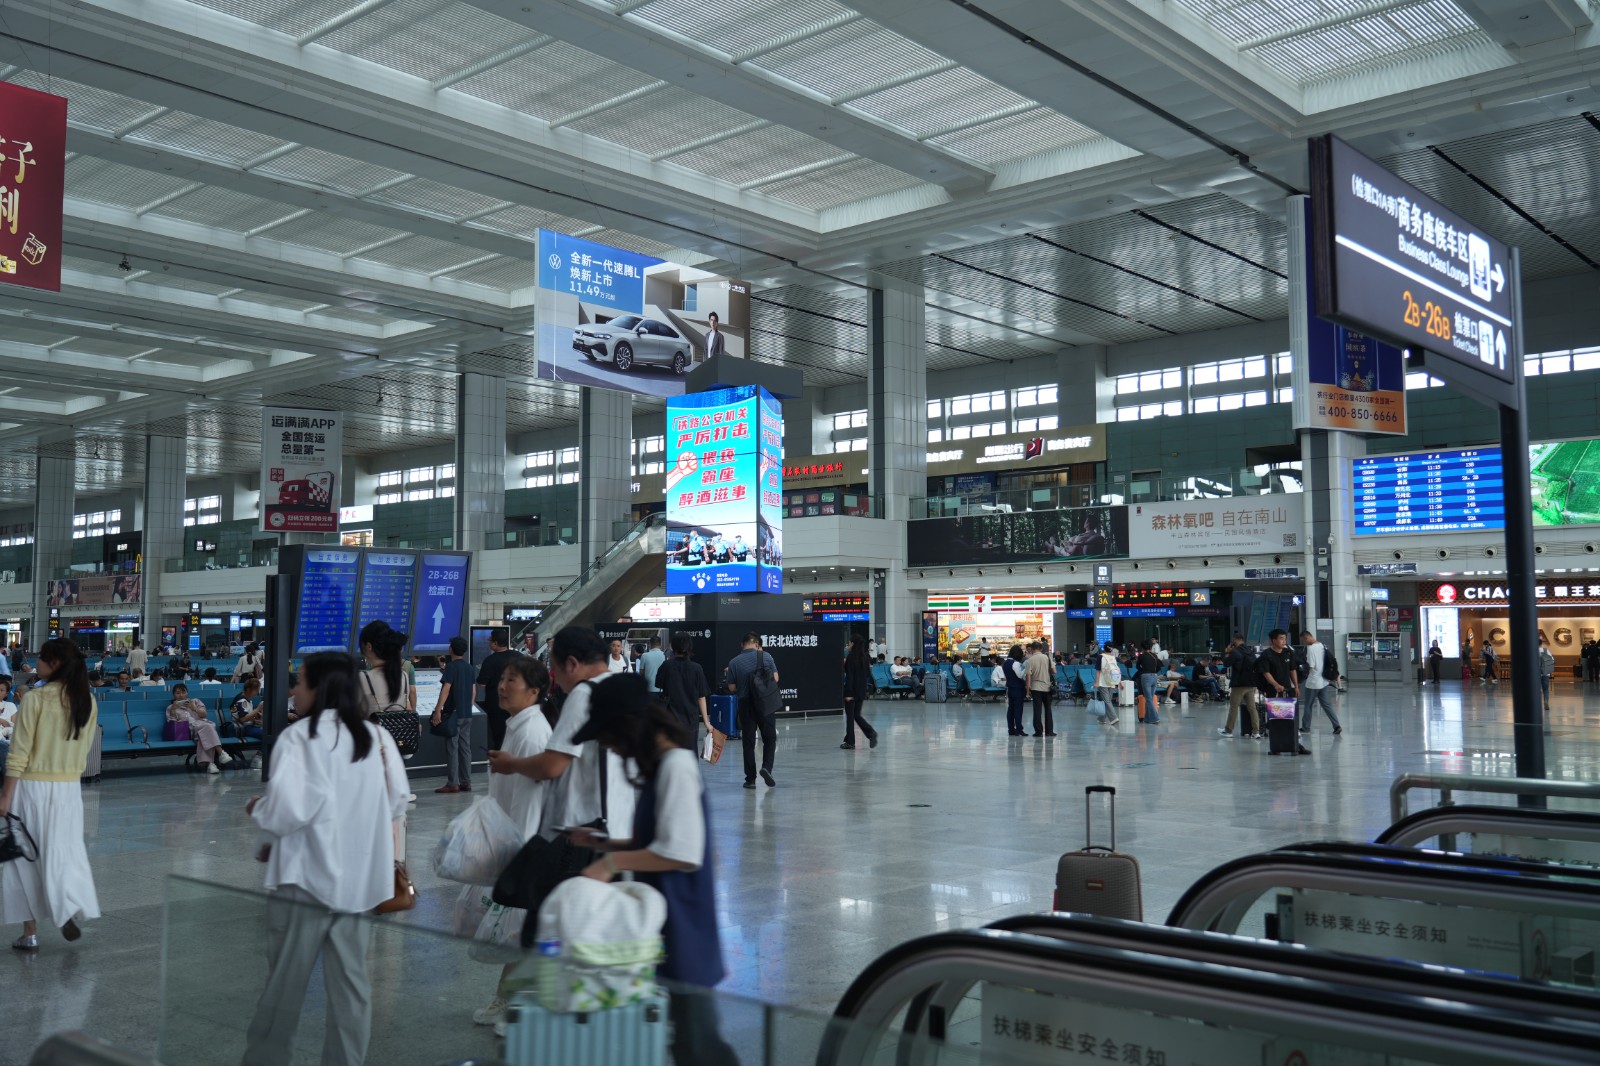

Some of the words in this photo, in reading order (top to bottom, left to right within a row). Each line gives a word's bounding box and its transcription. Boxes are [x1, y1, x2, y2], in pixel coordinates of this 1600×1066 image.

[570, 251, 641, 279] 全新一代速腾L
[1398, 234, 1428, 266] Business
[1428, 247, 1447, 275] Class
[1447, 258, 1470, 289] Lounge
[569, 267, 613, 287] 焕新上市
[1454, 311, 1478, 342] 检票口
[271, 415, 336, 430] 运满满APP
[677, 406, 749, 432] 铁路公安机关
[1327, 405, 1398, 423] 400-850-6666
[281, 431, 325, 444] 全国货运
[676, 422, 749, 448] 严厉打击
[281, 443, 326, 455] 总量第一
[926, 449, 964, 463] 务贵宾厅
[701, 466, 736, 485] 霸座
[678, 484, 747, 508] 醉酒滋事
[1151, 511, 1215, 531] 森林氧吧
[1222, 507, 1287, 527] 自在南山
[318, 553, 348, 561] 出发信息
[428, 570, 459, 580] 2B-26B
[428, 585, 455, 597] 检票口
[1098, 589, 1108, 597] 2A
[1194, 592, 1206, 602] 2A
[1464, 586, 1547, 599] CHAE
[1098, 597, 1109, 605] 3A
[760, 634, 818, 648] 重庆北站欢迎您
[1488, 628, 1595, 647] CAGE
[1304, 910, 1447, 944] 扶梯乘坐安全须知
[993, 1014, 1167, 1066] 扶梯乘坐安全须知
